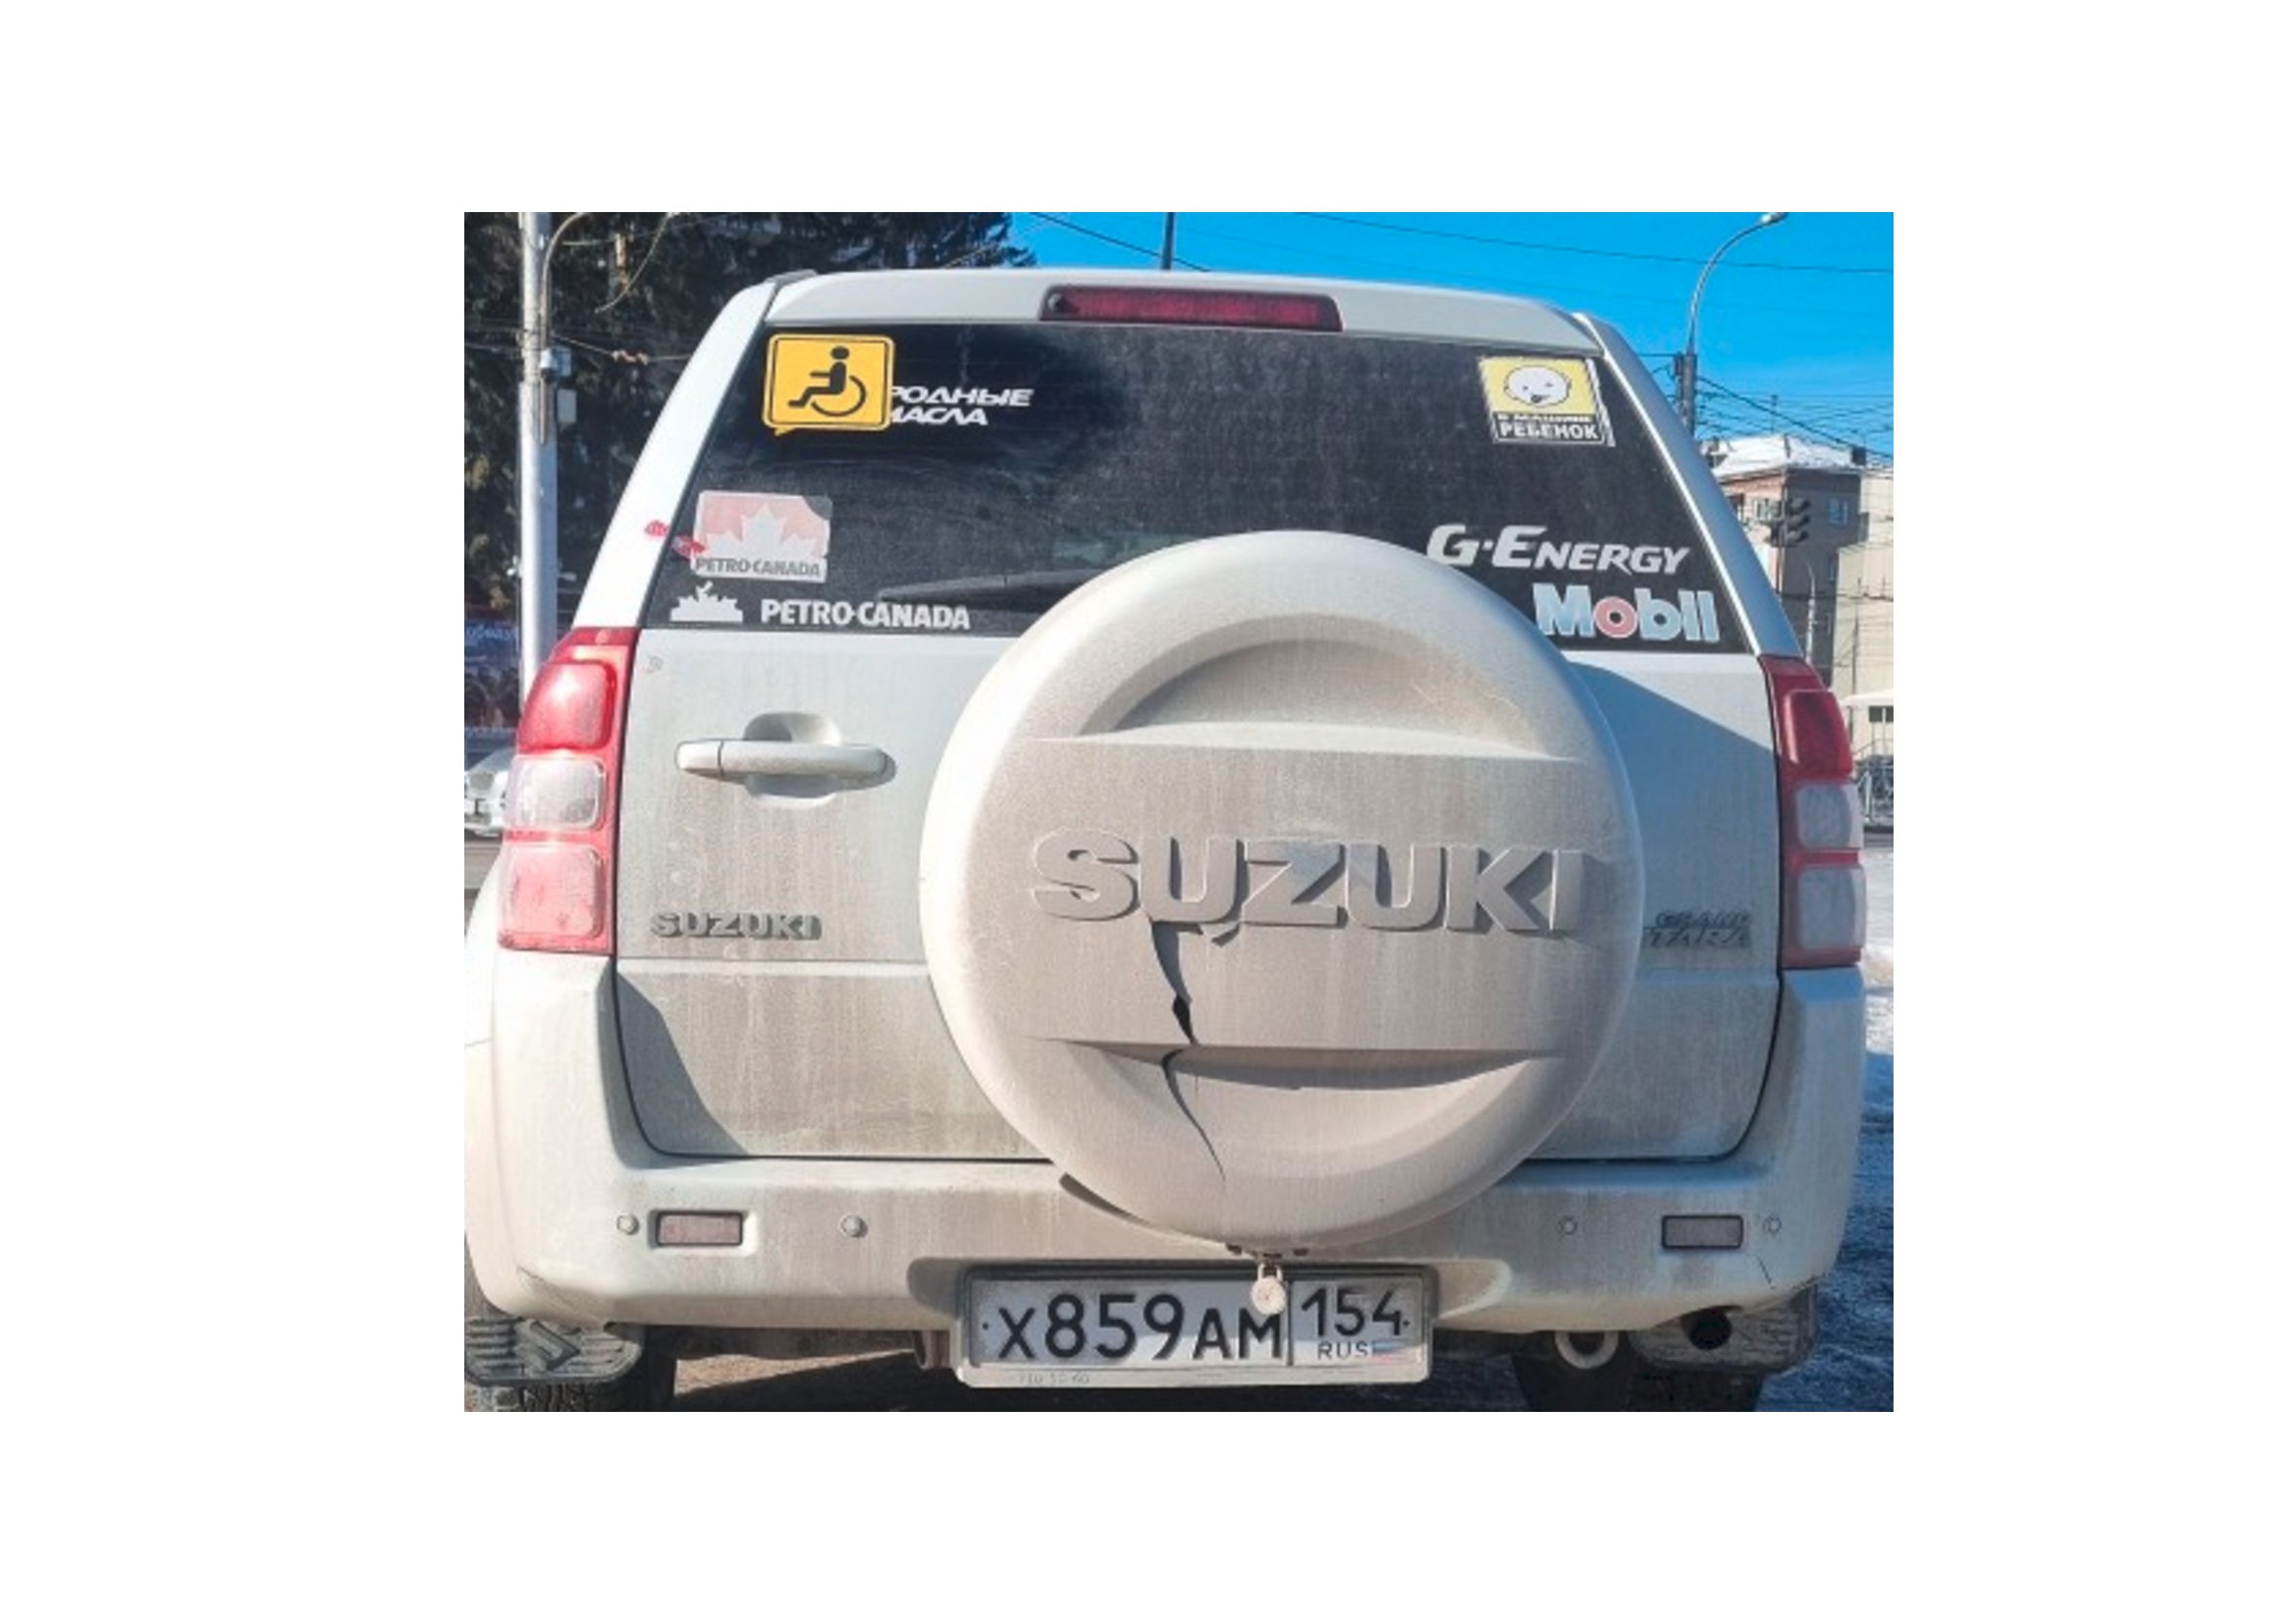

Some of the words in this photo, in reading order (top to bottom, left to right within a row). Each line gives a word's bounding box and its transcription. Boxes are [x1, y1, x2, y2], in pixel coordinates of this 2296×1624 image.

[1032, 830, 1583, 935] SUZUKI
[650, 911, 823, 940] SUZUKI
[1316, 1341, 1369, 1359] RUS
